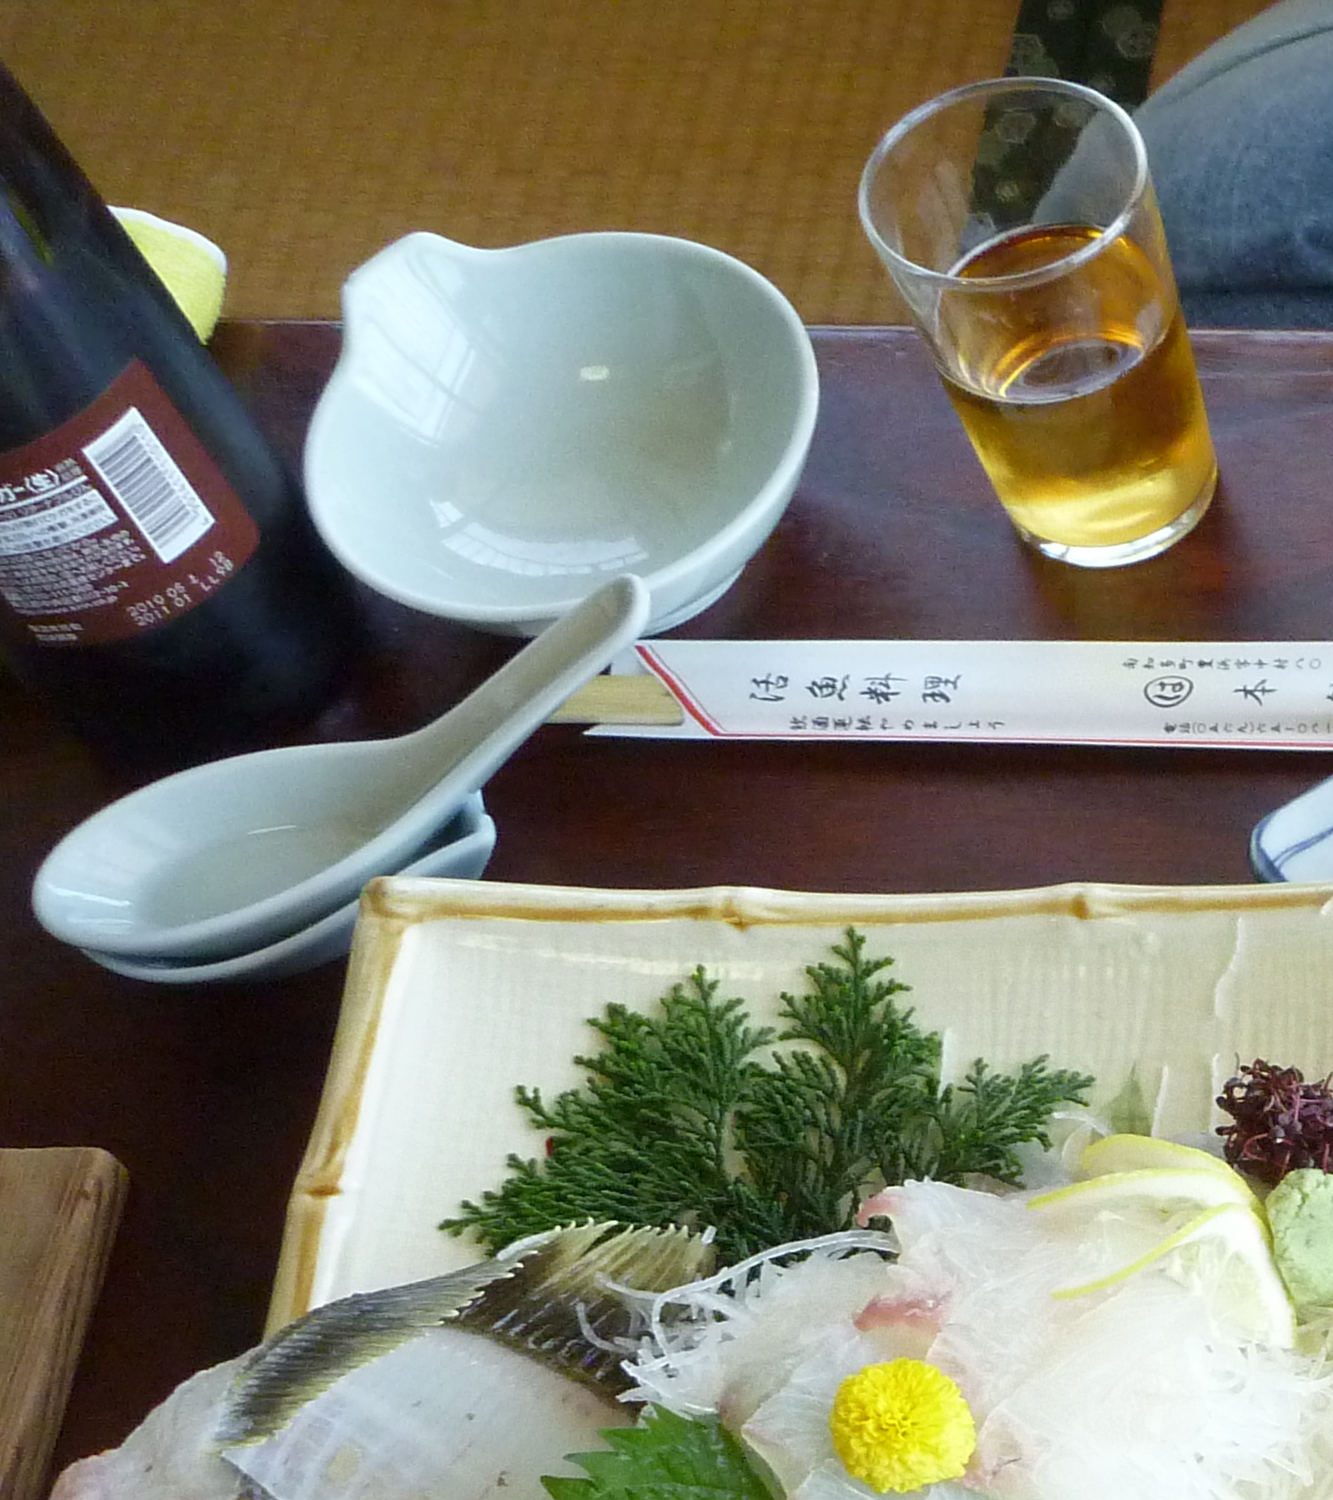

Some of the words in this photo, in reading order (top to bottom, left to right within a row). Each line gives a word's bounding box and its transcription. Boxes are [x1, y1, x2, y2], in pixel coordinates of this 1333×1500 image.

[748, 671, 963, 704] 活魚料理
[788, 714, 1007, 733] 飲酒運転やめましょう
